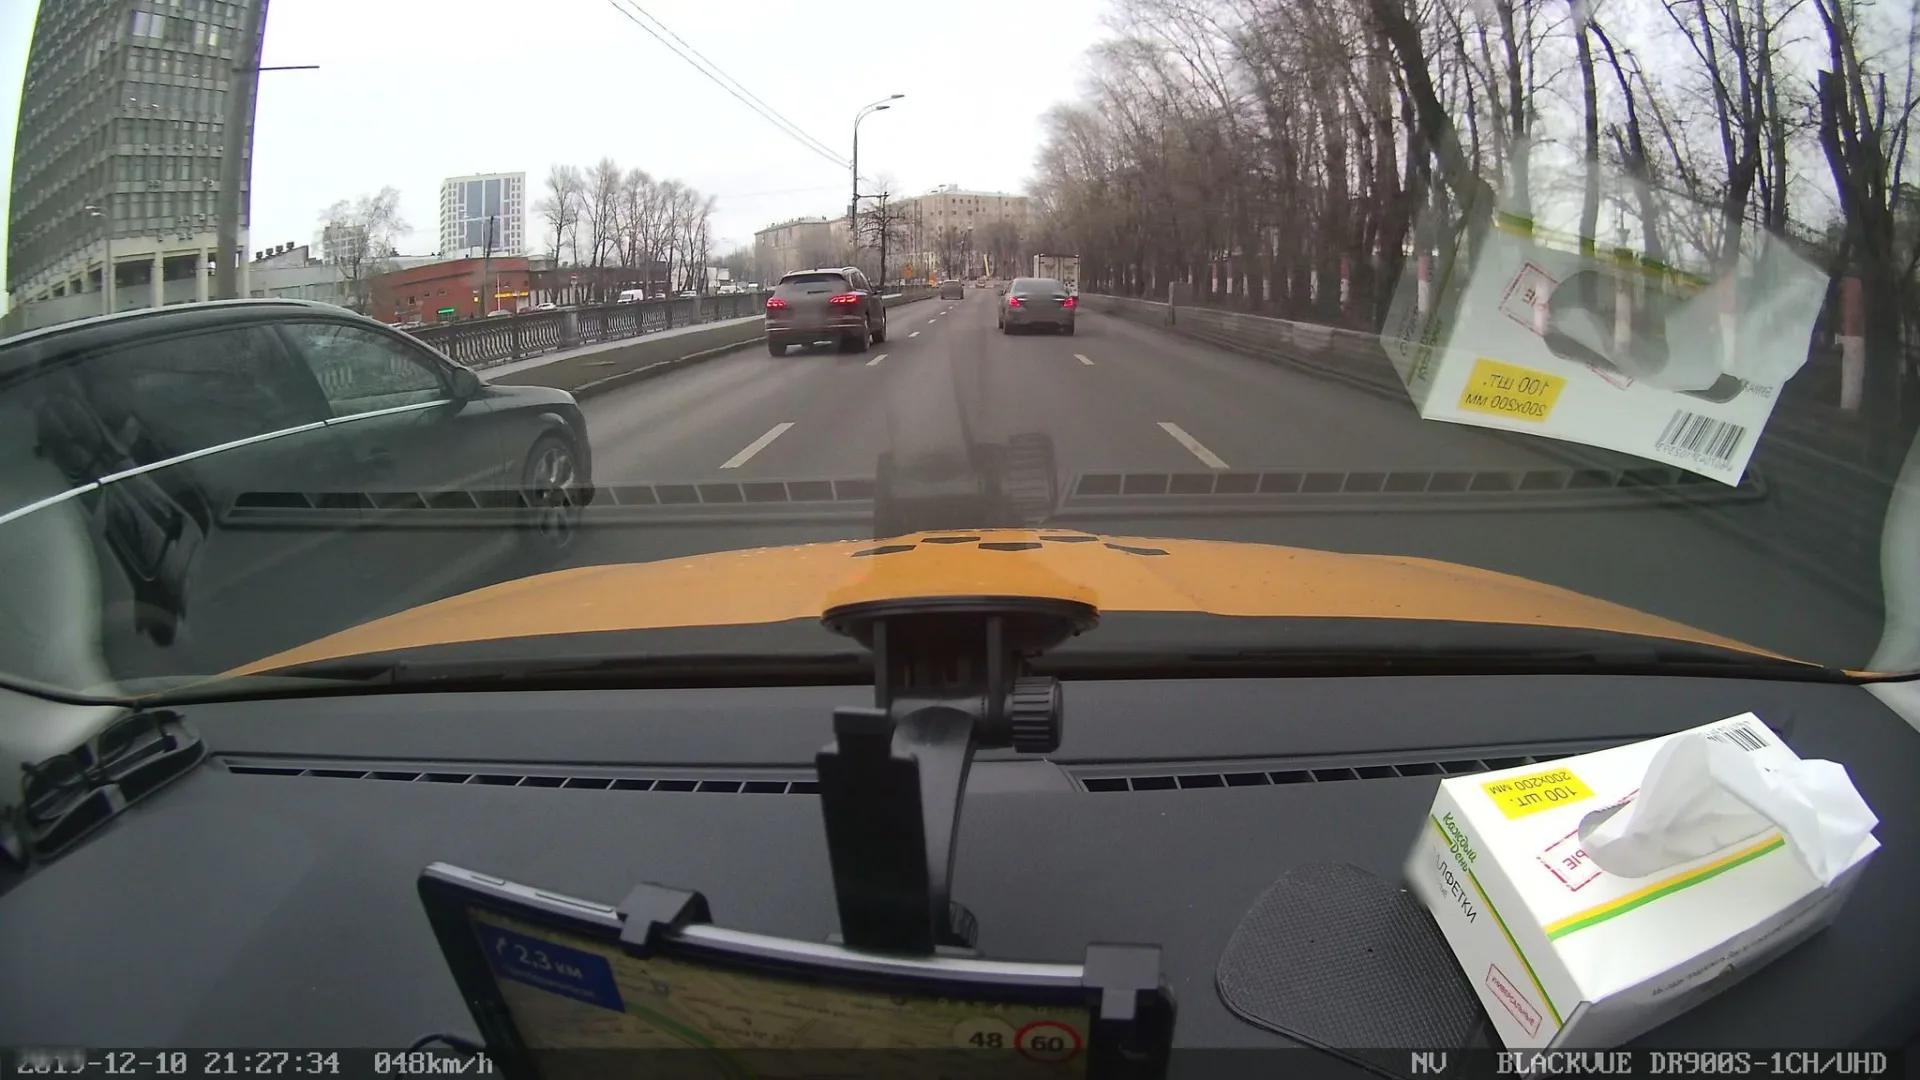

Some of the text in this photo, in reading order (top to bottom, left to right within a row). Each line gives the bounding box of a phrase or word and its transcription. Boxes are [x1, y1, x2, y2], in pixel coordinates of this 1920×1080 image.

[1544, 786, 1578, 802] 100
[514, 944, 552, 971] 2,3
[968, 1031, 1004, 1049] 48
[1030, 1035, 1065, 1053] 60
